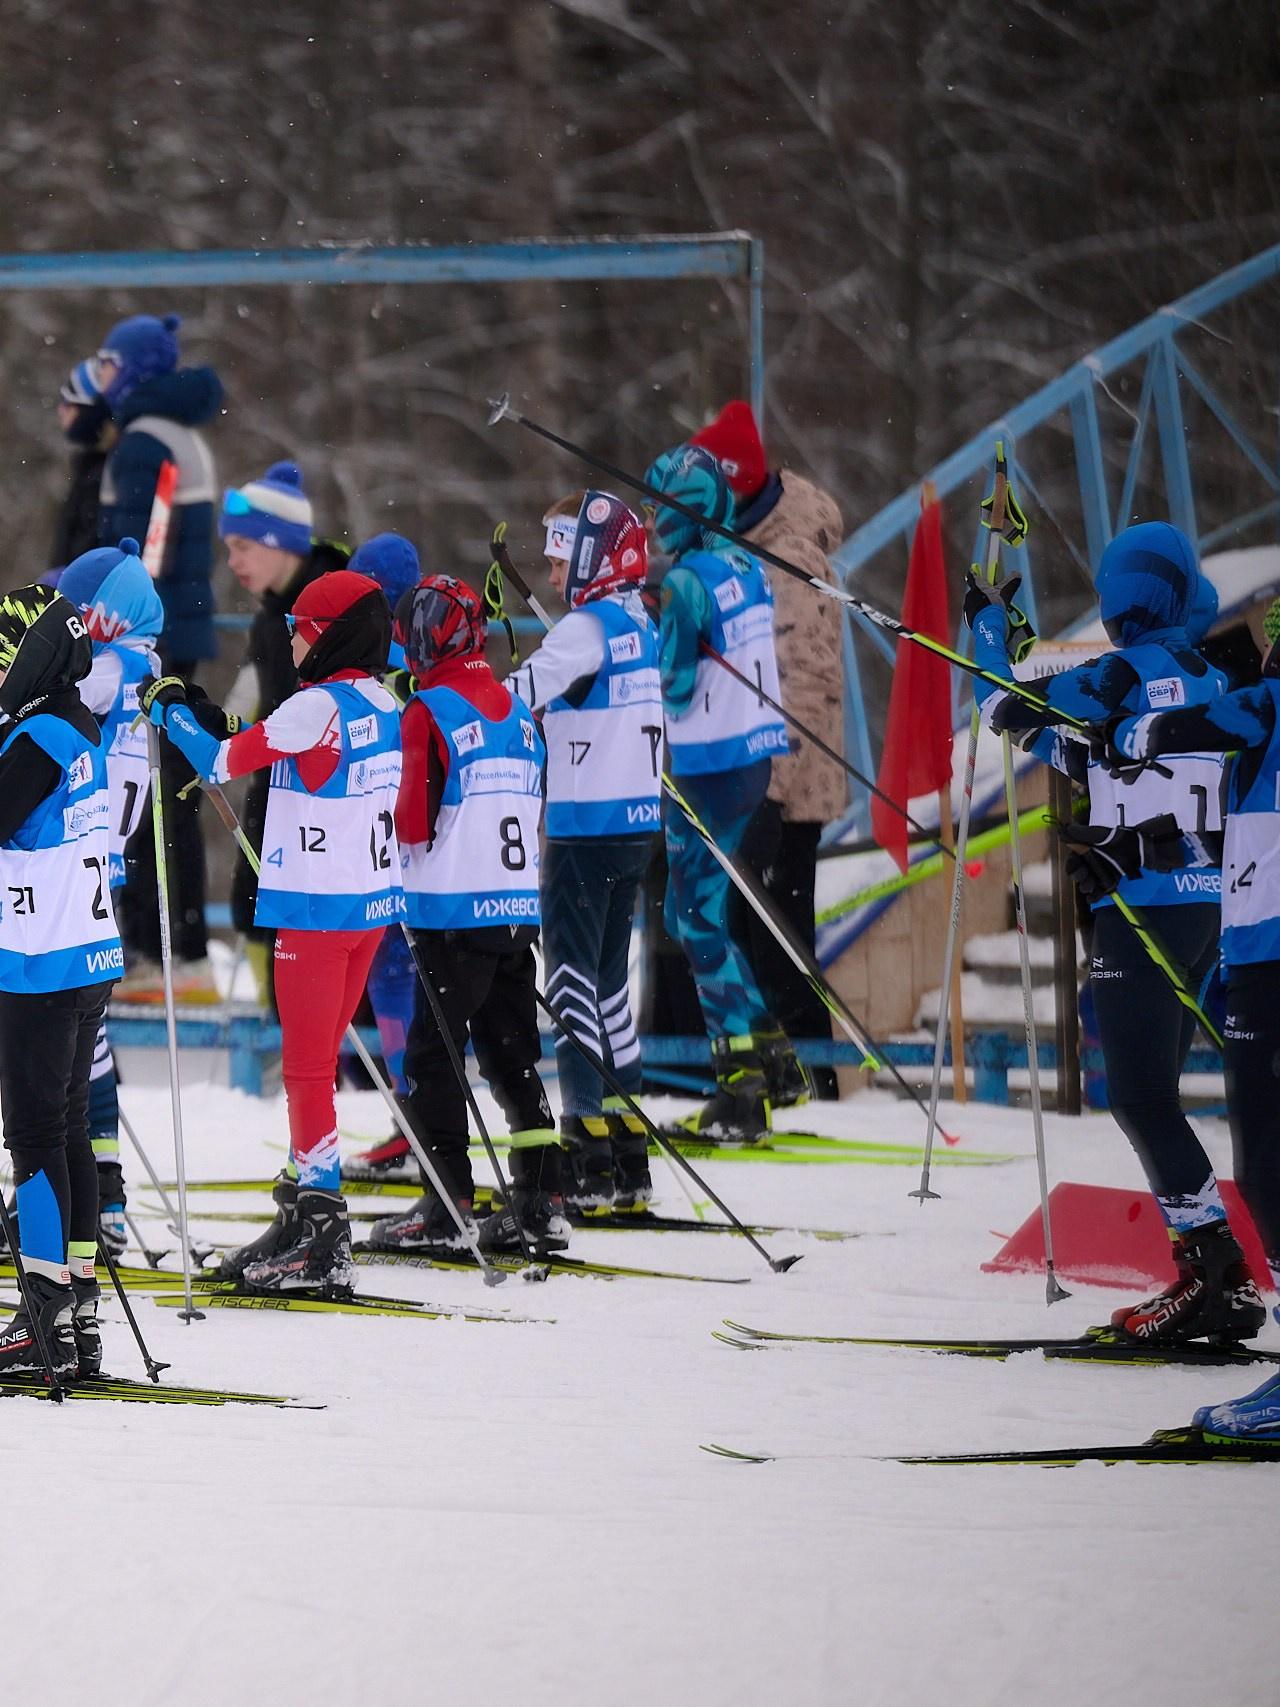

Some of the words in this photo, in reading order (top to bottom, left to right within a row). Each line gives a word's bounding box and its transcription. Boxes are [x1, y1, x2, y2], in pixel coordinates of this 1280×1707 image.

[1149, 688, 1170, 698] СБР
[568, 741, 592, 766] 17
[299, 826, 326, 853] 12
[499, 816, 526, 871] 8
[266, 847, 284, 868] 4
[8, 886, 35, 915] 21
[355, 1253, 433, 1268] FISCHER
[208, 1297, 290, 1310] FISCHER
